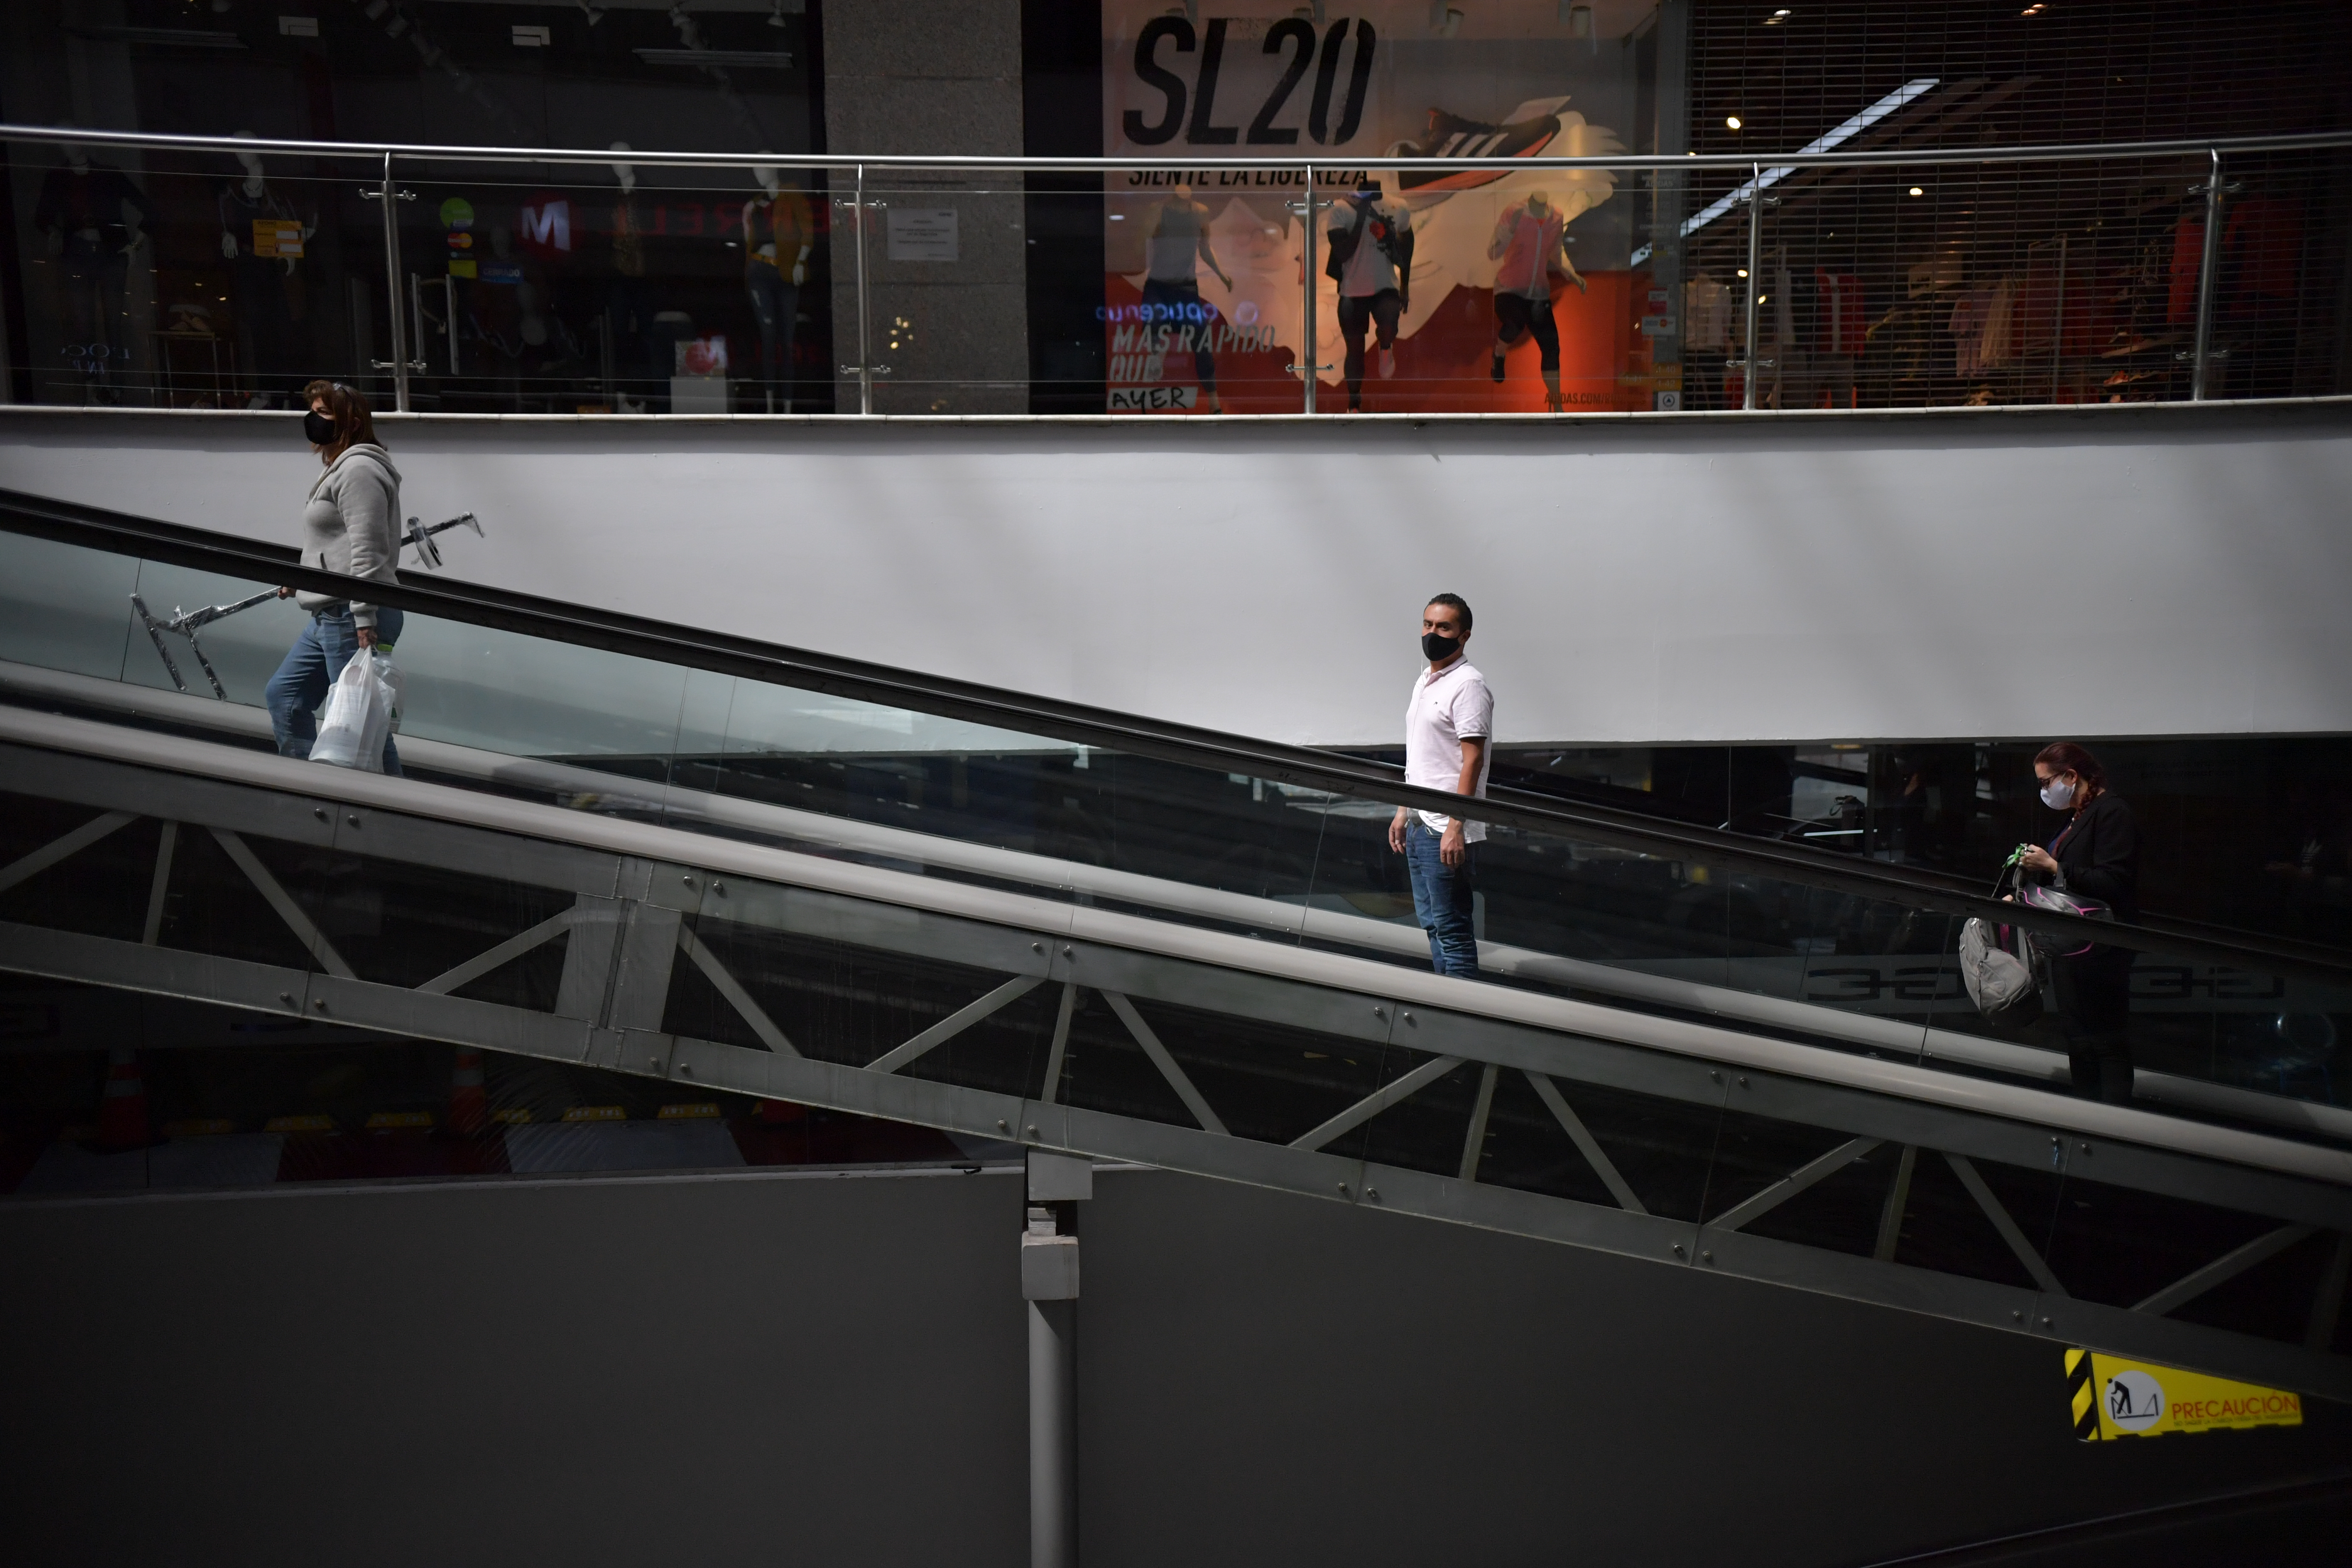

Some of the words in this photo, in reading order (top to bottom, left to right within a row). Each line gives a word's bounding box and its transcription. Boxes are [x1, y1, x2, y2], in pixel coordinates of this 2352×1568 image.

[1124, 17, 1375, 145] SL20
[1112, 387, 1187, 414] AYER
[2172, 1391, 2298, 1420] PRECAUCIÓN
